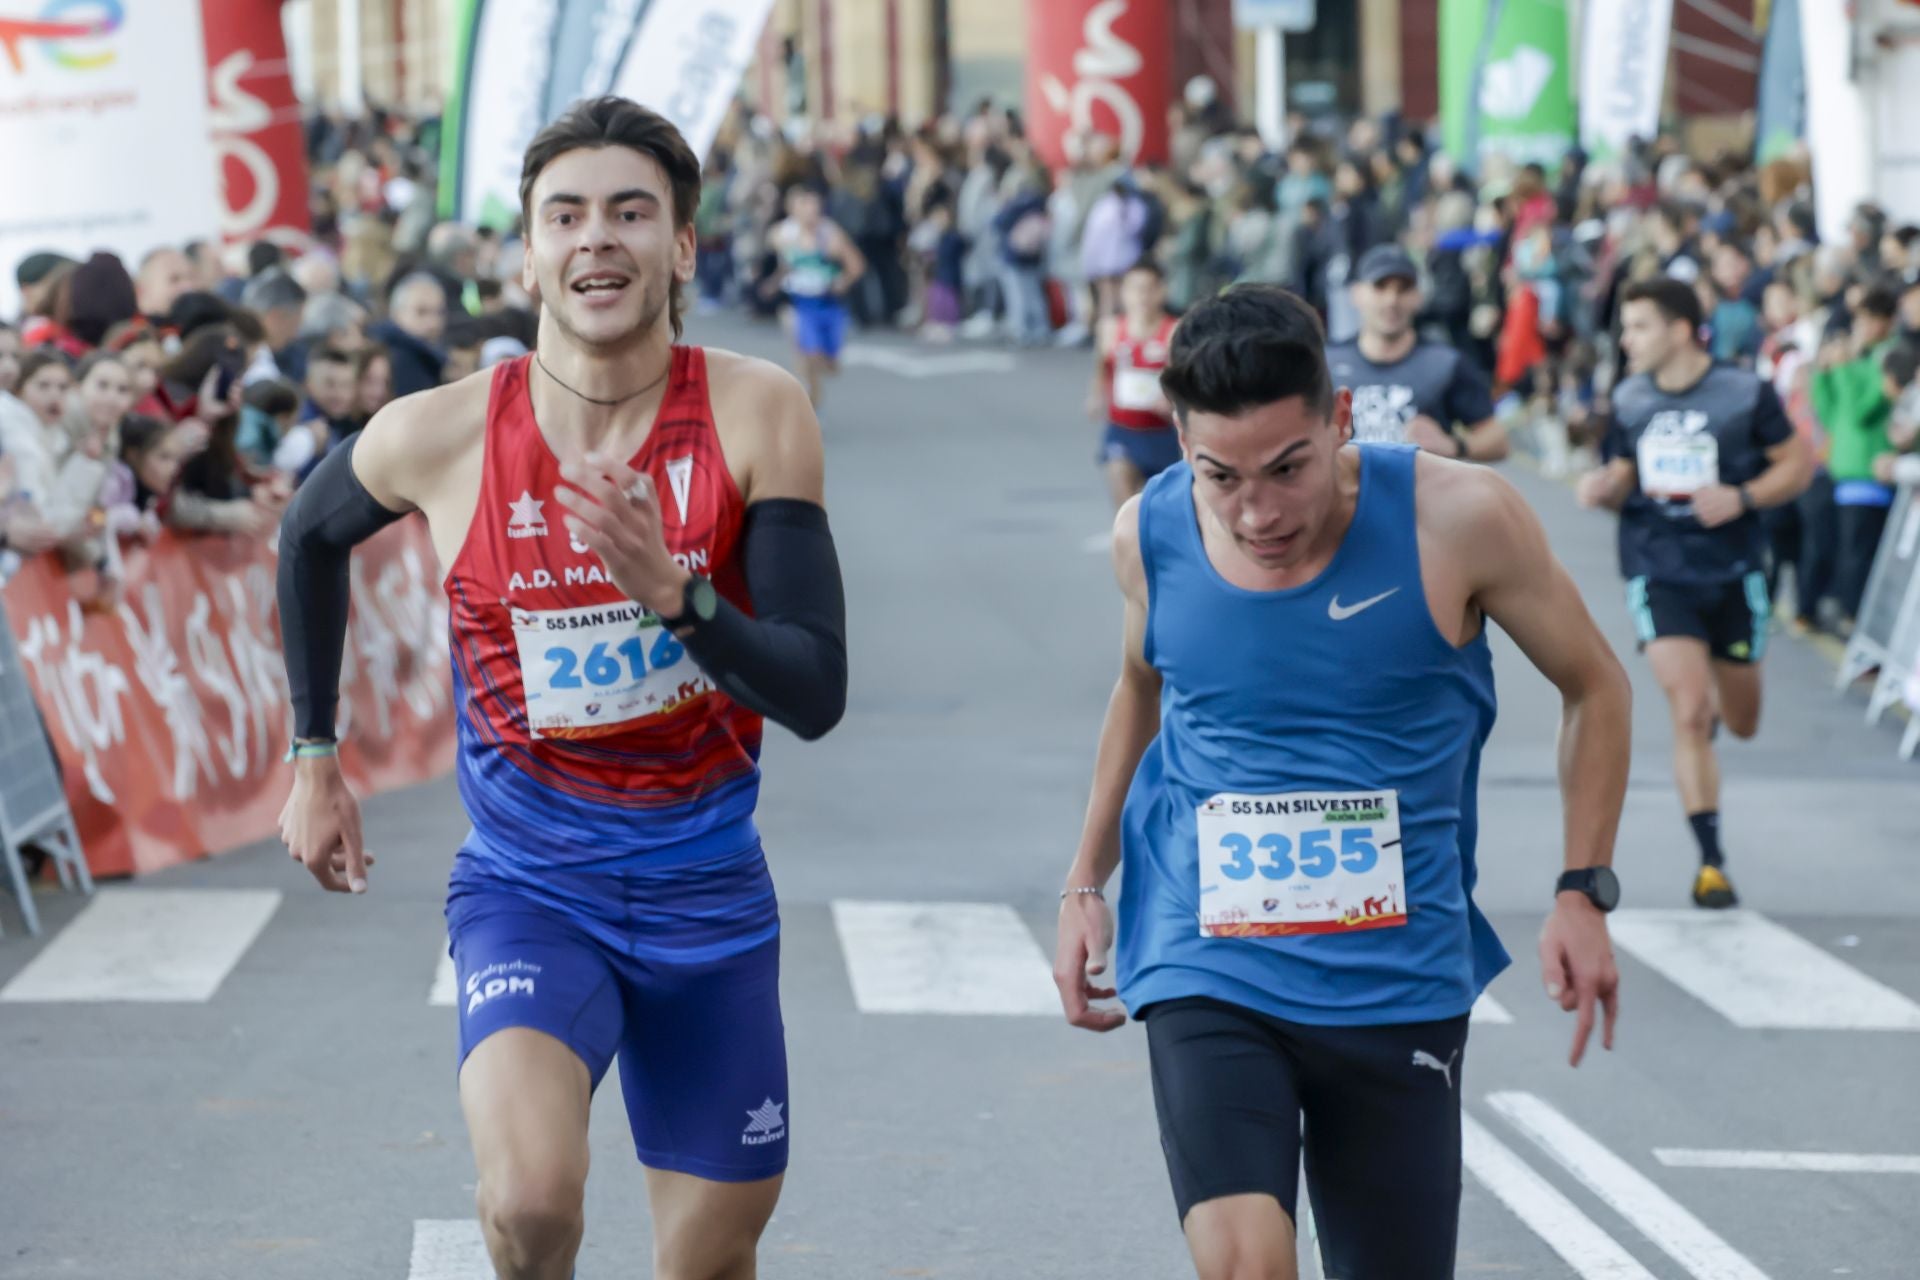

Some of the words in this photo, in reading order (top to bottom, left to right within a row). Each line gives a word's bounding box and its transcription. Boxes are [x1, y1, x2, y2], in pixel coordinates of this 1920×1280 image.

[508, 569, 557, 591] A.D.
[564, 548, 708, 586] MAON
[546, 616, 567, 631] 55
[569, 612, 604, 629] SAN
[544, 630, 684, 689] 2616
[1232, 801, 1252, 815] 55
[1255, 801, 1290, 815] SAN
[1293, 797, 1384, 813] SILVESTRE
[1219, 828, 1379, 881] 3355
[742, 1126, 785, 1145] luanvi
